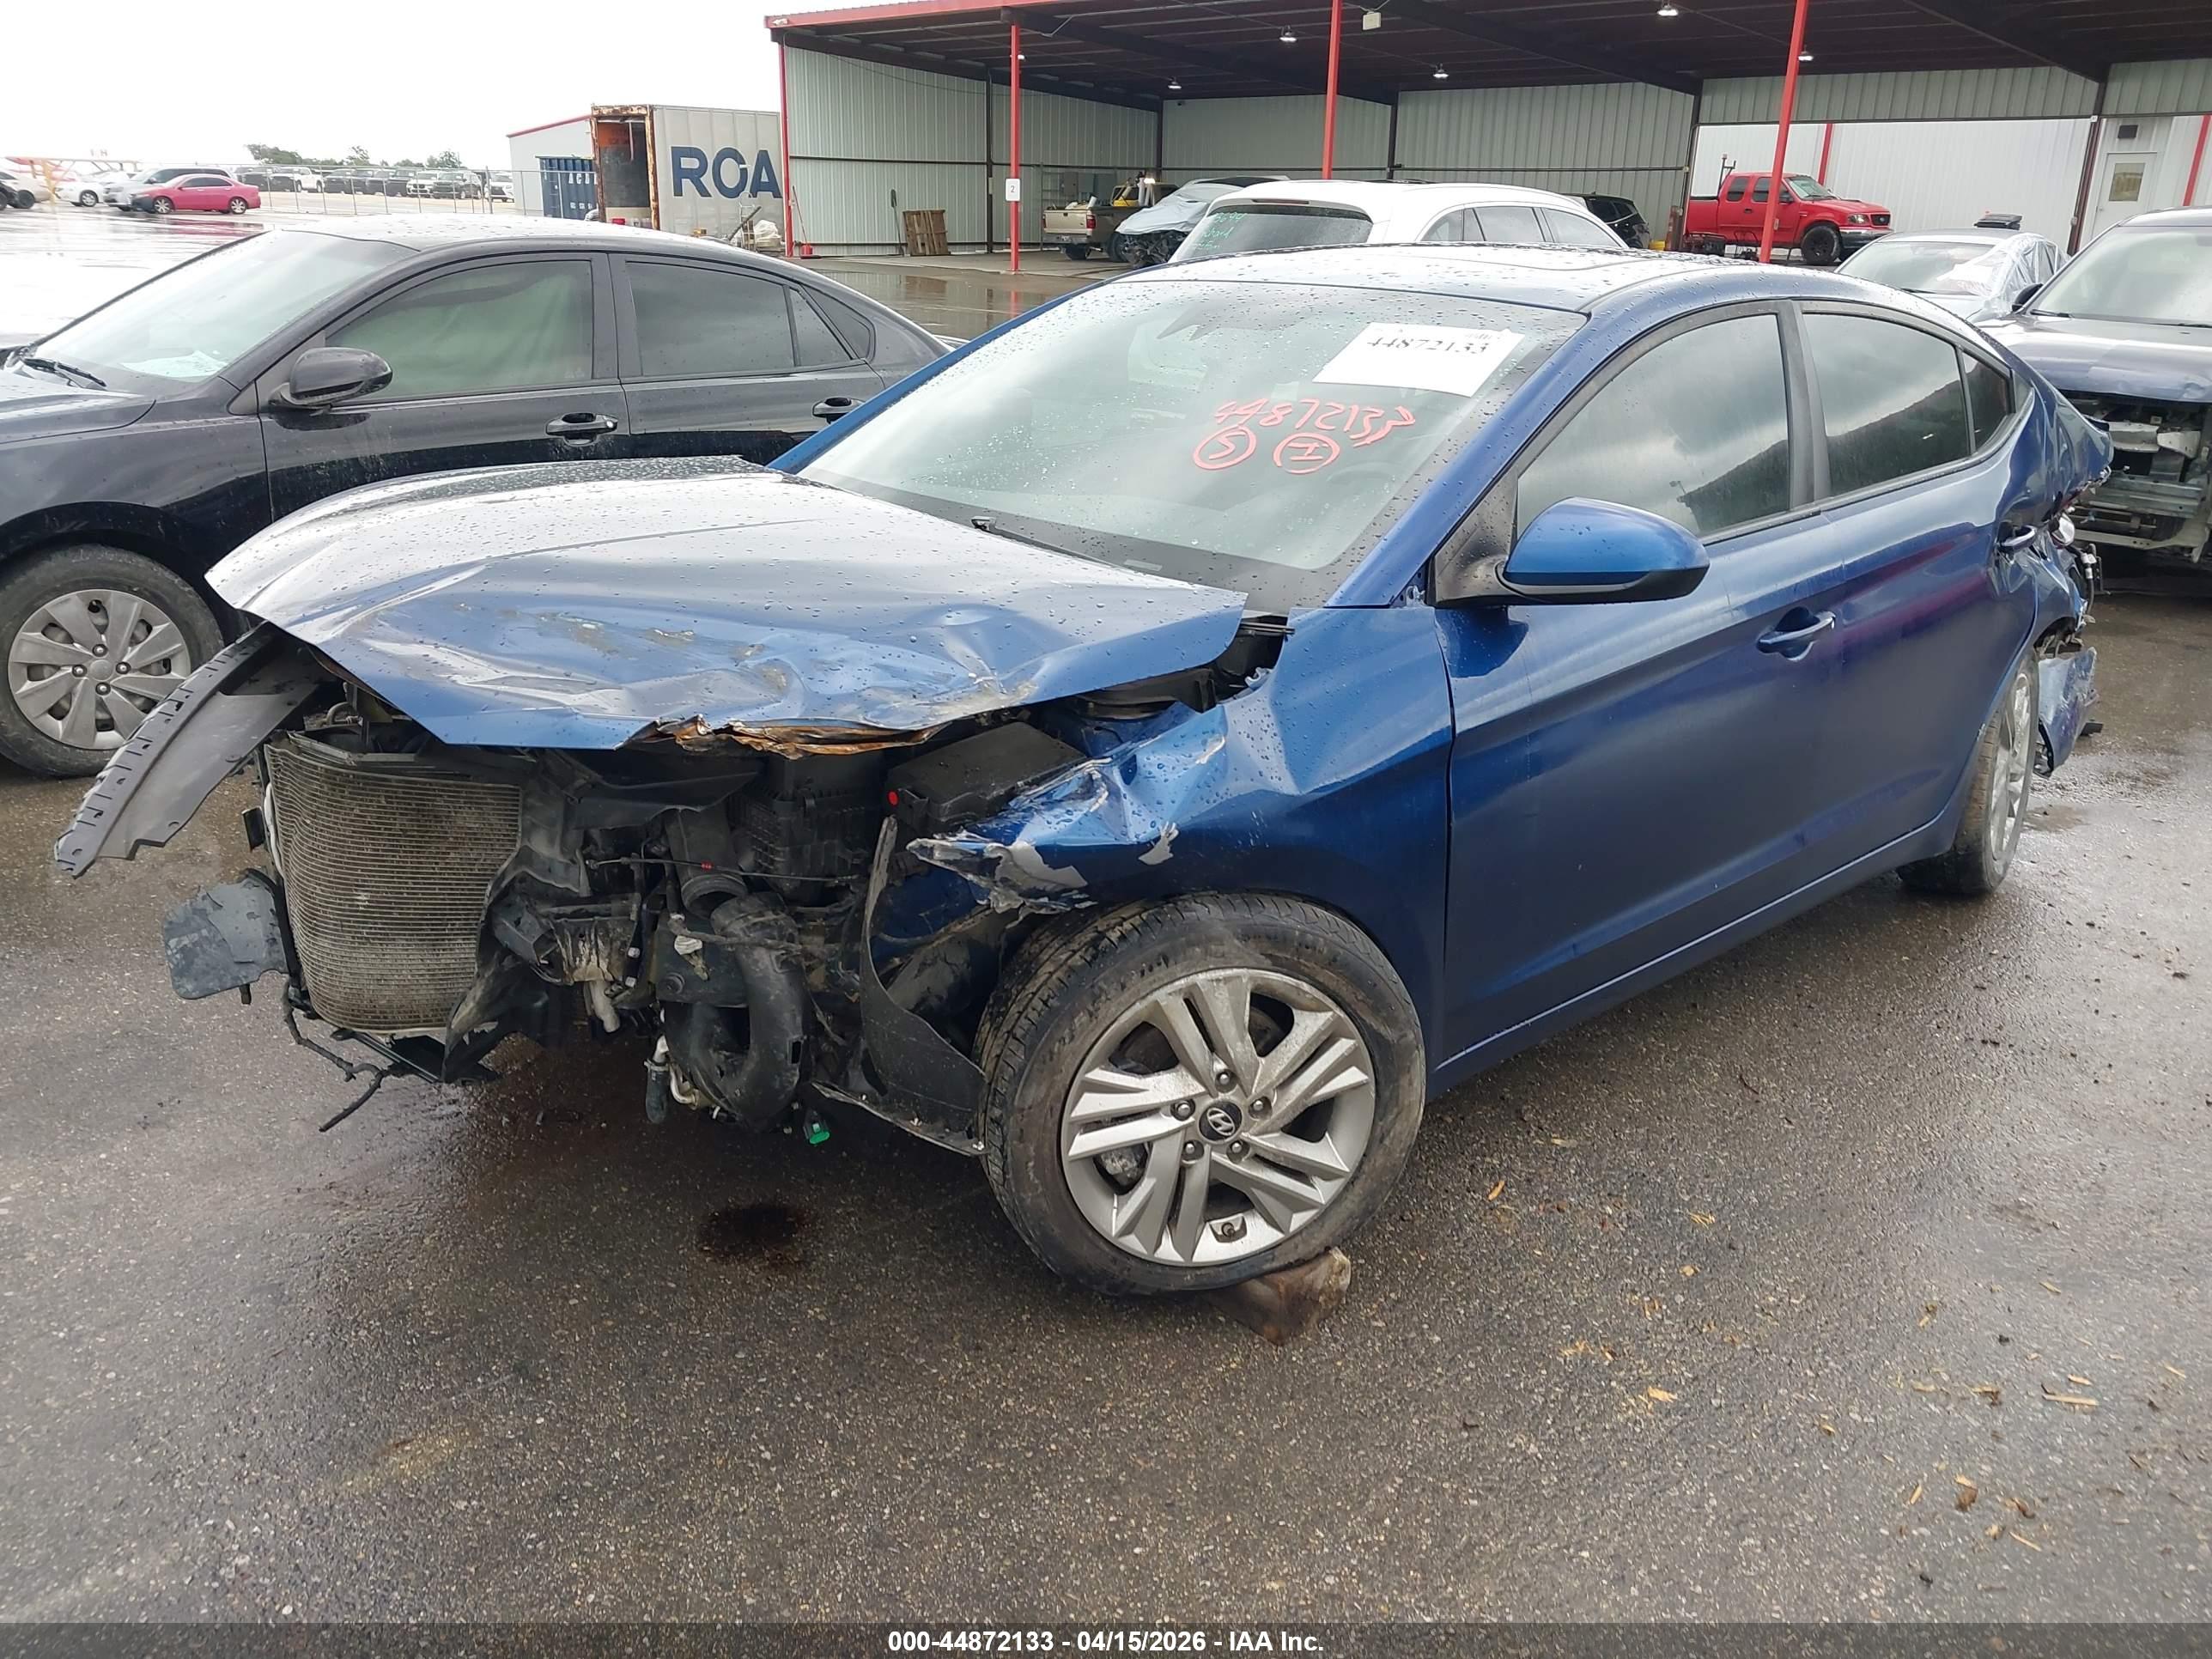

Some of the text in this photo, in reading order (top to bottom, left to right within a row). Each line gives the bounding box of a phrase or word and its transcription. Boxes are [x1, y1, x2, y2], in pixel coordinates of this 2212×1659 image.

[671, 146, 782, 198] ROA
[1010, 185, 1015, 193] 2
[1214, 398, 1415, 448] 44872133
